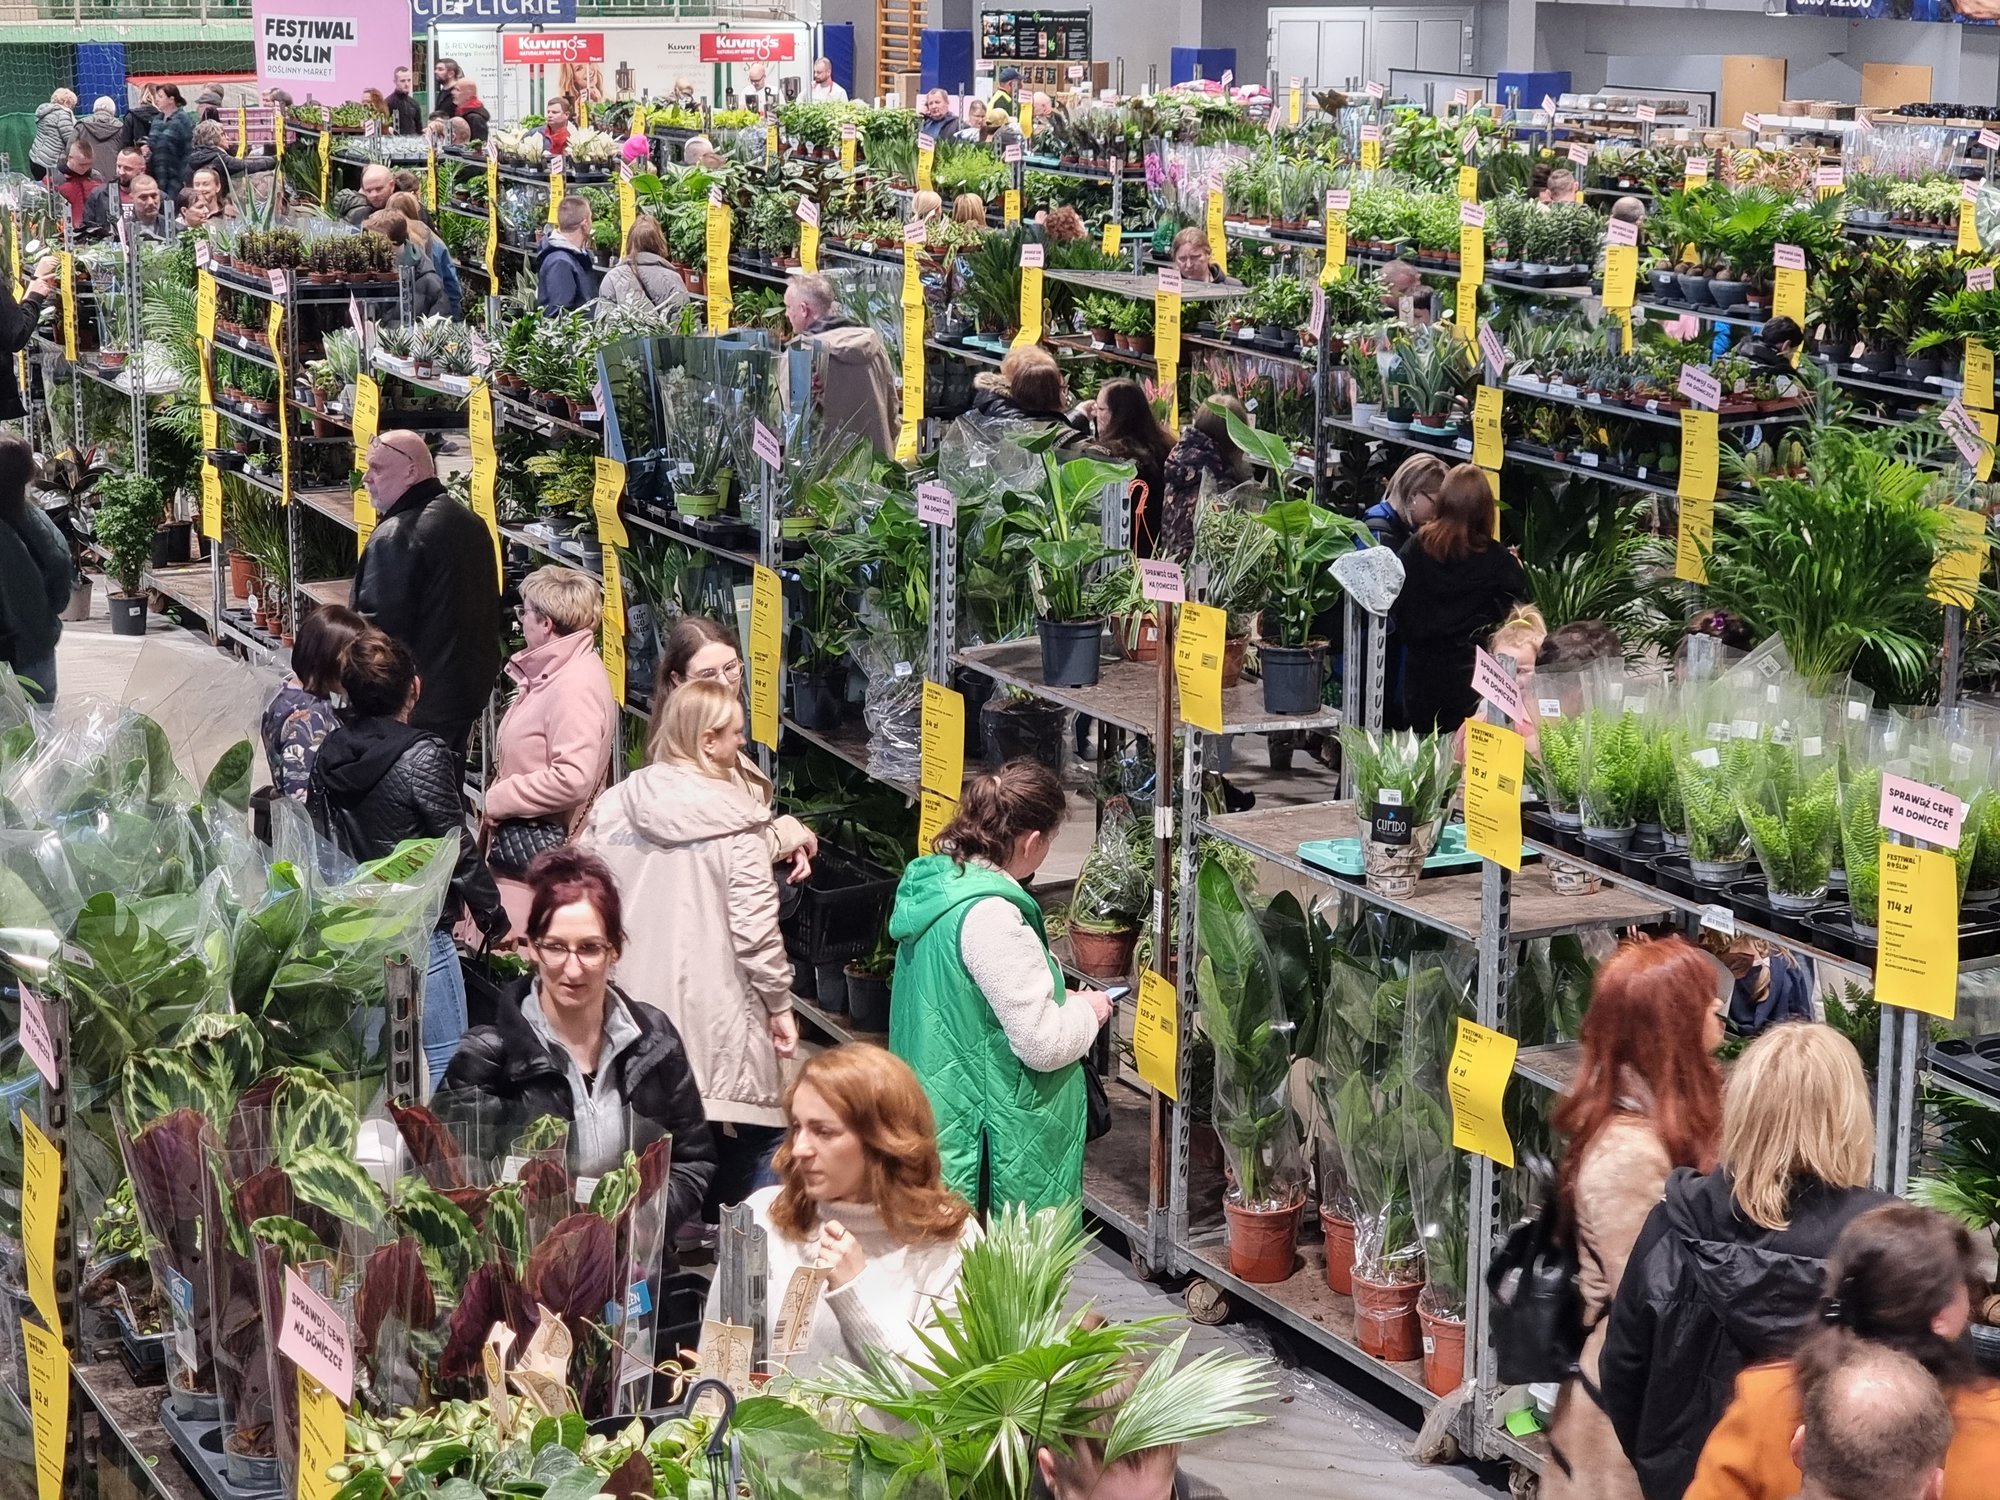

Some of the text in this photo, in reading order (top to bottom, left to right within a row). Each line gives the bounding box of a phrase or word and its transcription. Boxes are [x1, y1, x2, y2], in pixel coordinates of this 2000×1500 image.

[413, 0, 561, 15] CIEPLICKIE
[265, 18, 354, 40] FESTIWAL
[267, 39, 331, 64] ROŚLIN
[518, 35, 587, 61] Kuvings
[716, 35, 780, 60] Kuvings
[267, 65, 332, 77] ROŚLINNY MARKET
[1145, 568, 1179, 581] SPRAWDŹ CENĘ
[1156, 582, 1179, 592] DONICZCE
[1480, 659, 1518, 699] SPRAWDŹ CENĘ
[1481, 675, 1516, 708] NA DONICZCE
[1471, 766, 1487, 780] 15 zł
[1889, 788, 1954, 818] SPRAWDŹ CENĘ
[1376, 818, 1407, 832] CUPIDO
[1892, 805, 1949, 831] NA DONICZCE
[1886, 853, 1916, 864] FESTIWAL
[1886, 861, 1909, 870] ROŚLIN
[1887, 900, 1913, 914] 114 zł
[1140, 1008, 1155, 1022] 125 zł
[1453, 1066, 1467, 1078] 6 zł
[291, 1291, 346, 1353] SPRAWDŹ CENĘ
[293, 1318, 343, 1372] NA DONICZCE
[34, 1388, 49, 1408] 32 zł
